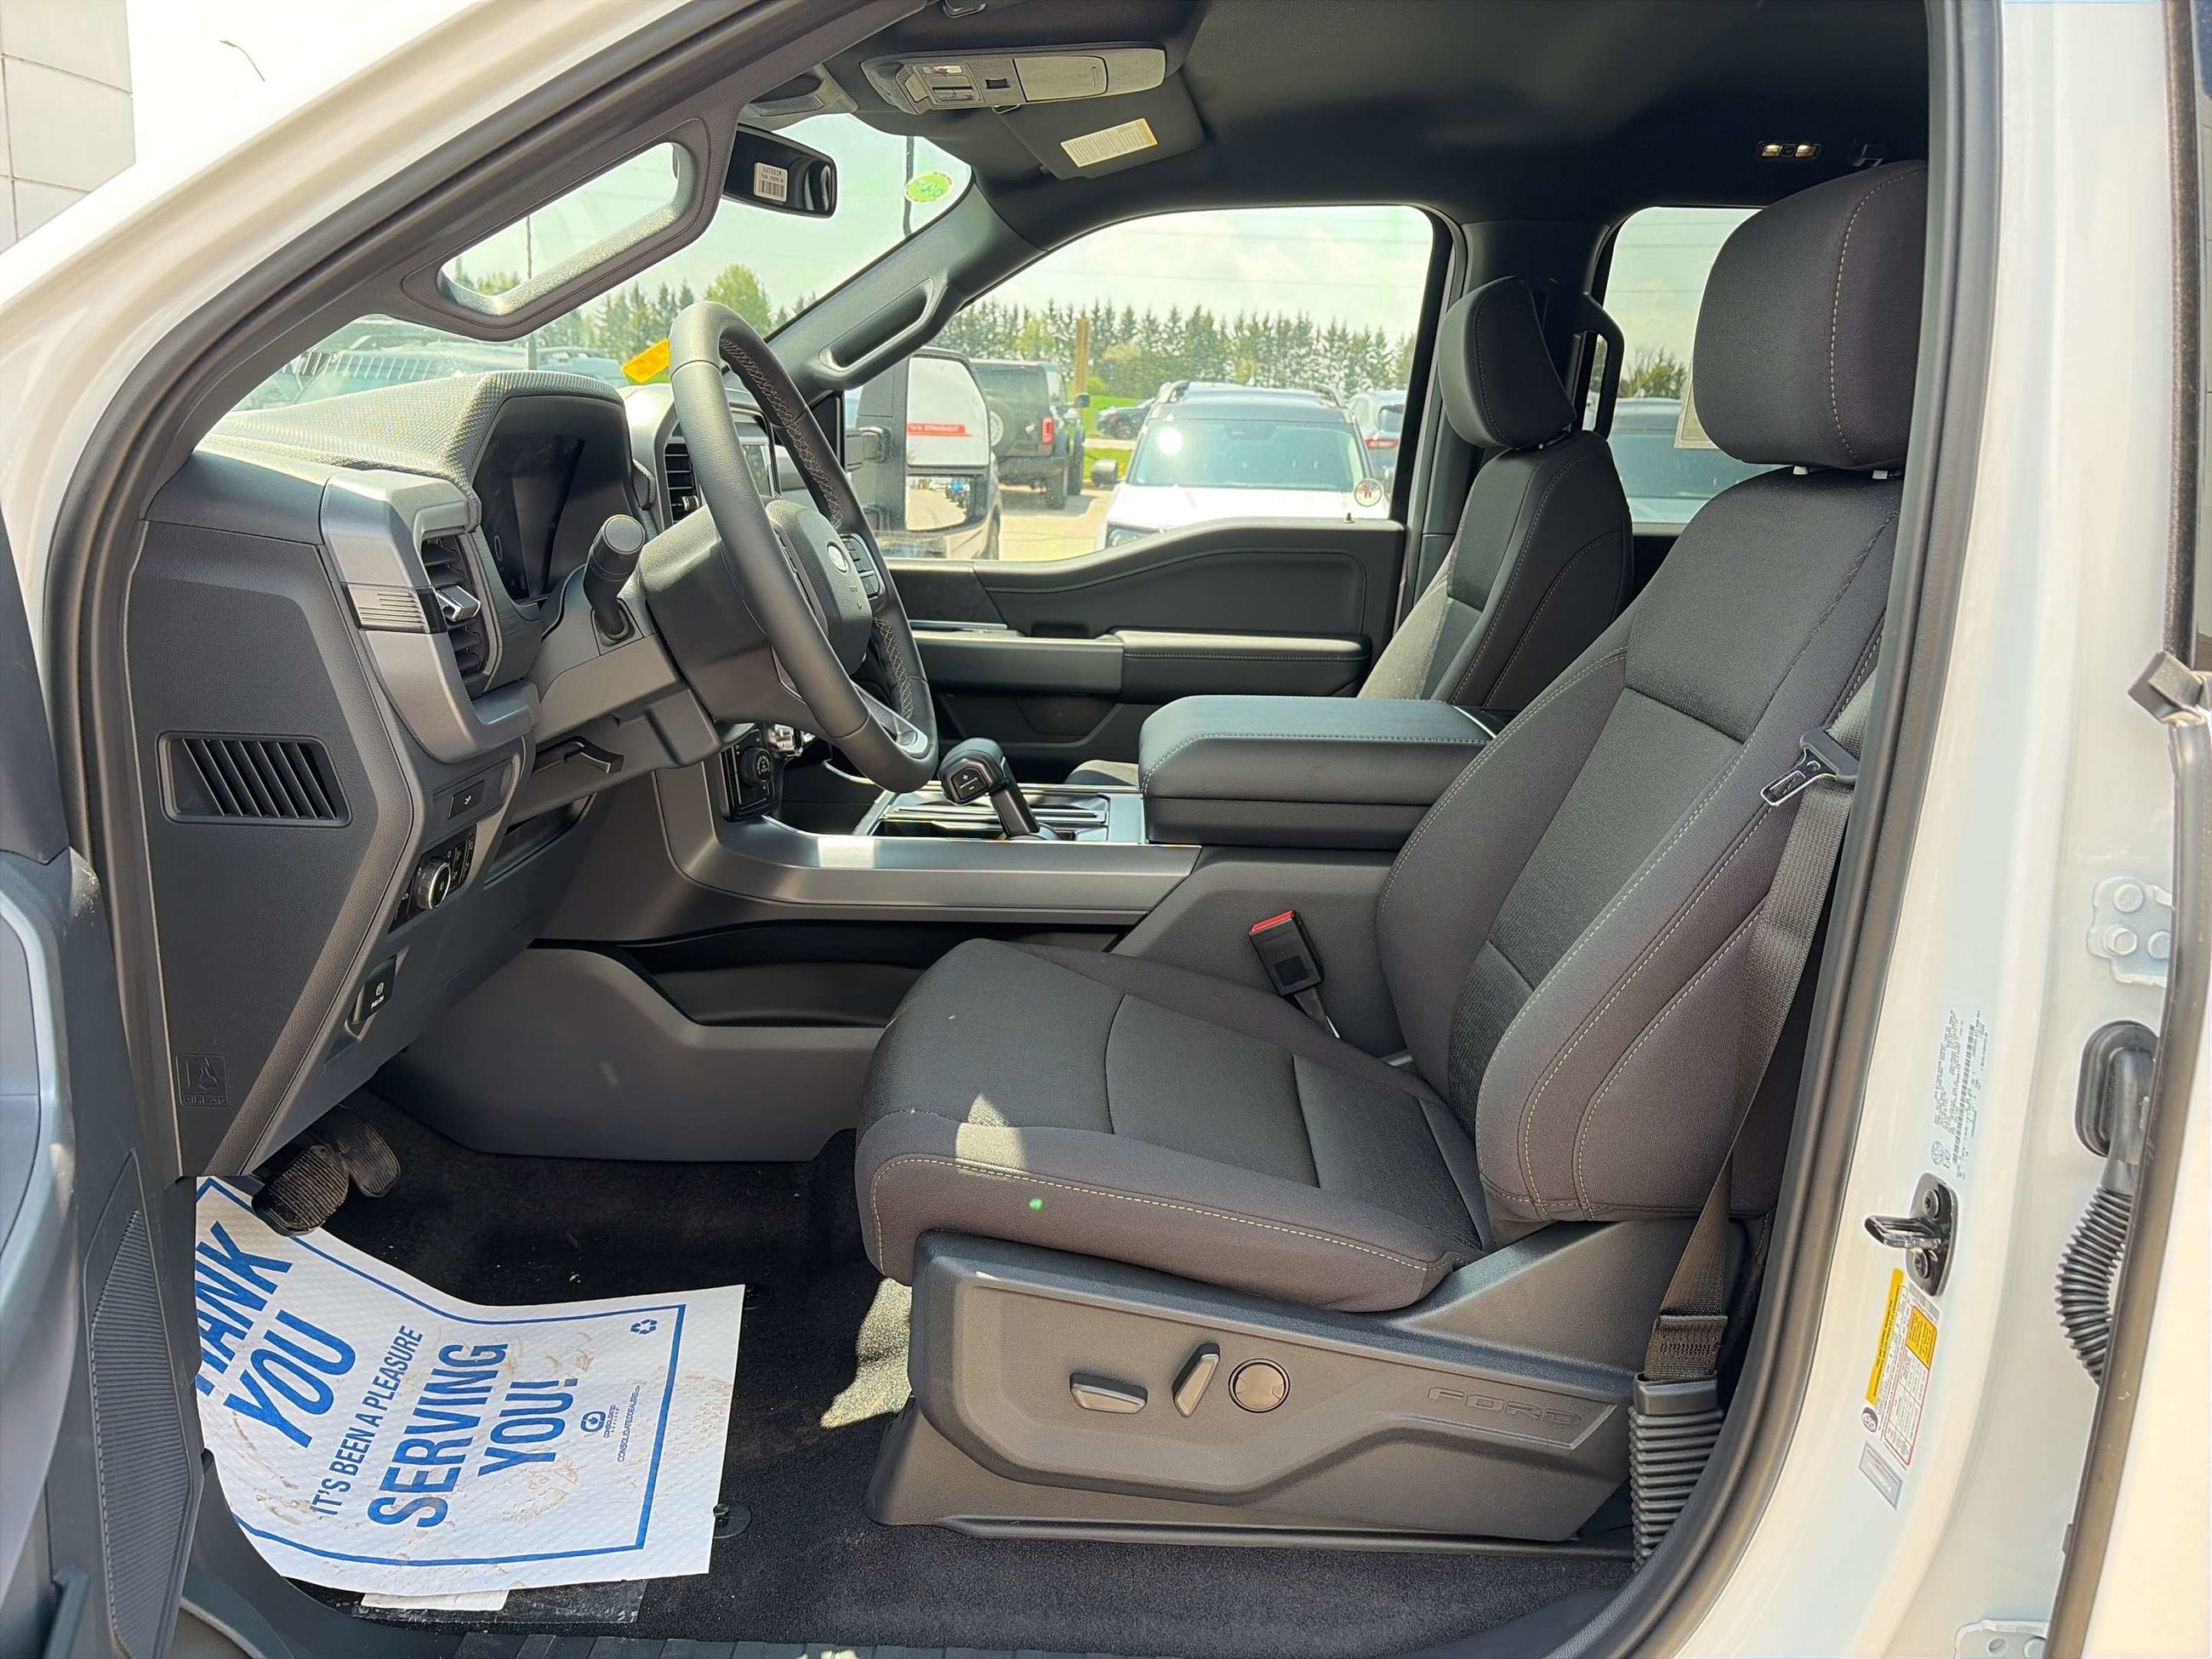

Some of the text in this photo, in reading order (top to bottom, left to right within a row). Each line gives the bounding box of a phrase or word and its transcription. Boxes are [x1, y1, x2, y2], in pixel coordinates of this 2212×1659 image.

[183, 1095, 227, 1105] AIRBAG
[223, 1308, 356, 1448] YOU
[309, 1325, 424, 1516] IT'S BEEN A PLEASURE
[367, 1343, 509, 1528] SERVING
[477, 1377, 579, 1477] YOU!
[1427, 1386, 1582, 1428] FORD
